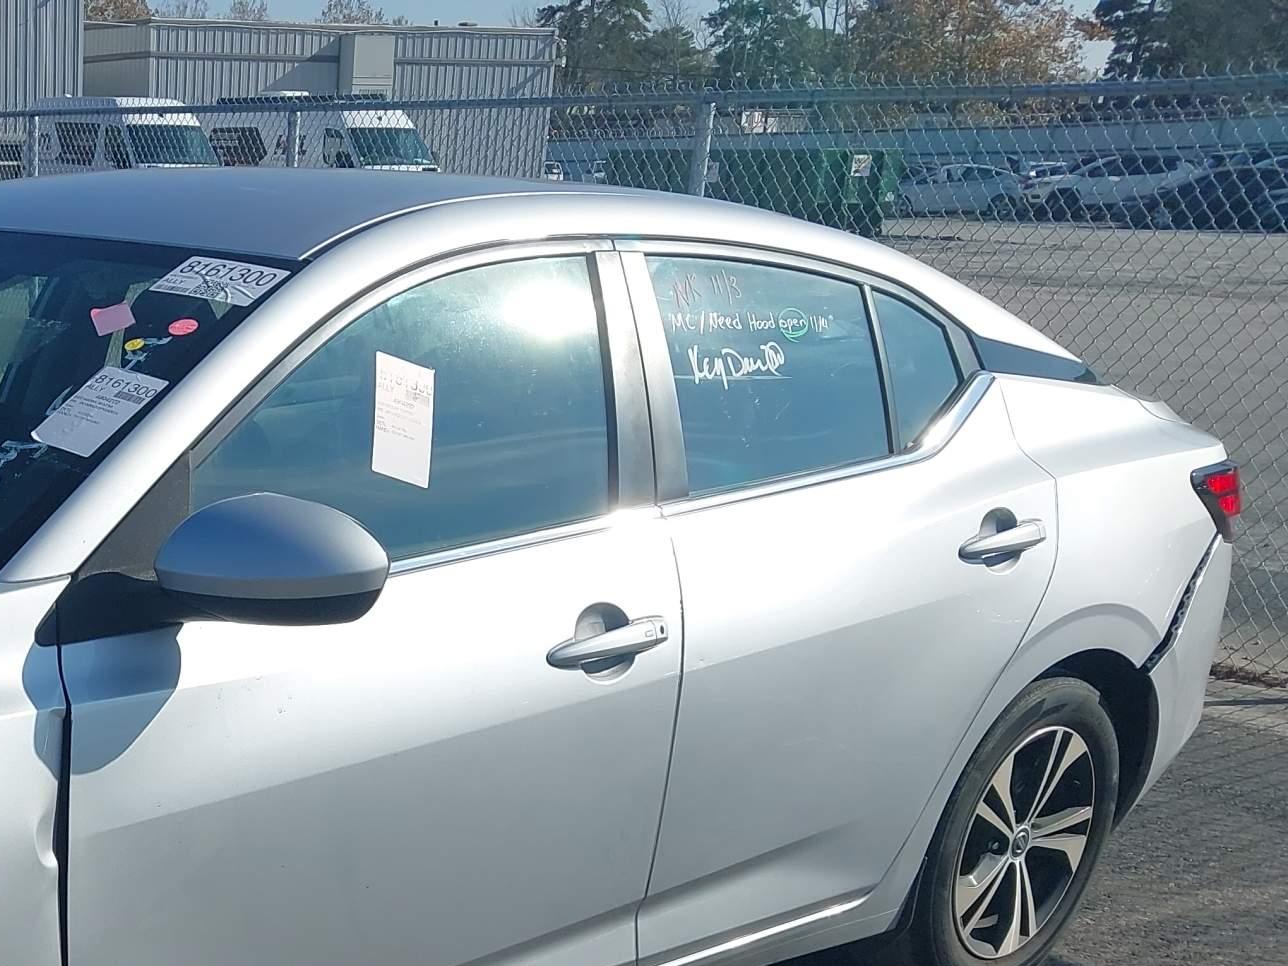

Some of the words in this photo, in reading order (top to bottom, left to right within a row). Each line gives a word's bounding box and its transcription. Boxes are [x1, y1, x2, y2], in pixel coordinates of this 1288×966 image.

[162, 276, 186, 286] ALLY
[179, 259, 278, 287] 8161300
[747, 311, 777, 333] Hood
[779, 317, 809, 334] open
[86, 383, 106, 393] ALLY
[94, 374, 158, 398] 8161300
